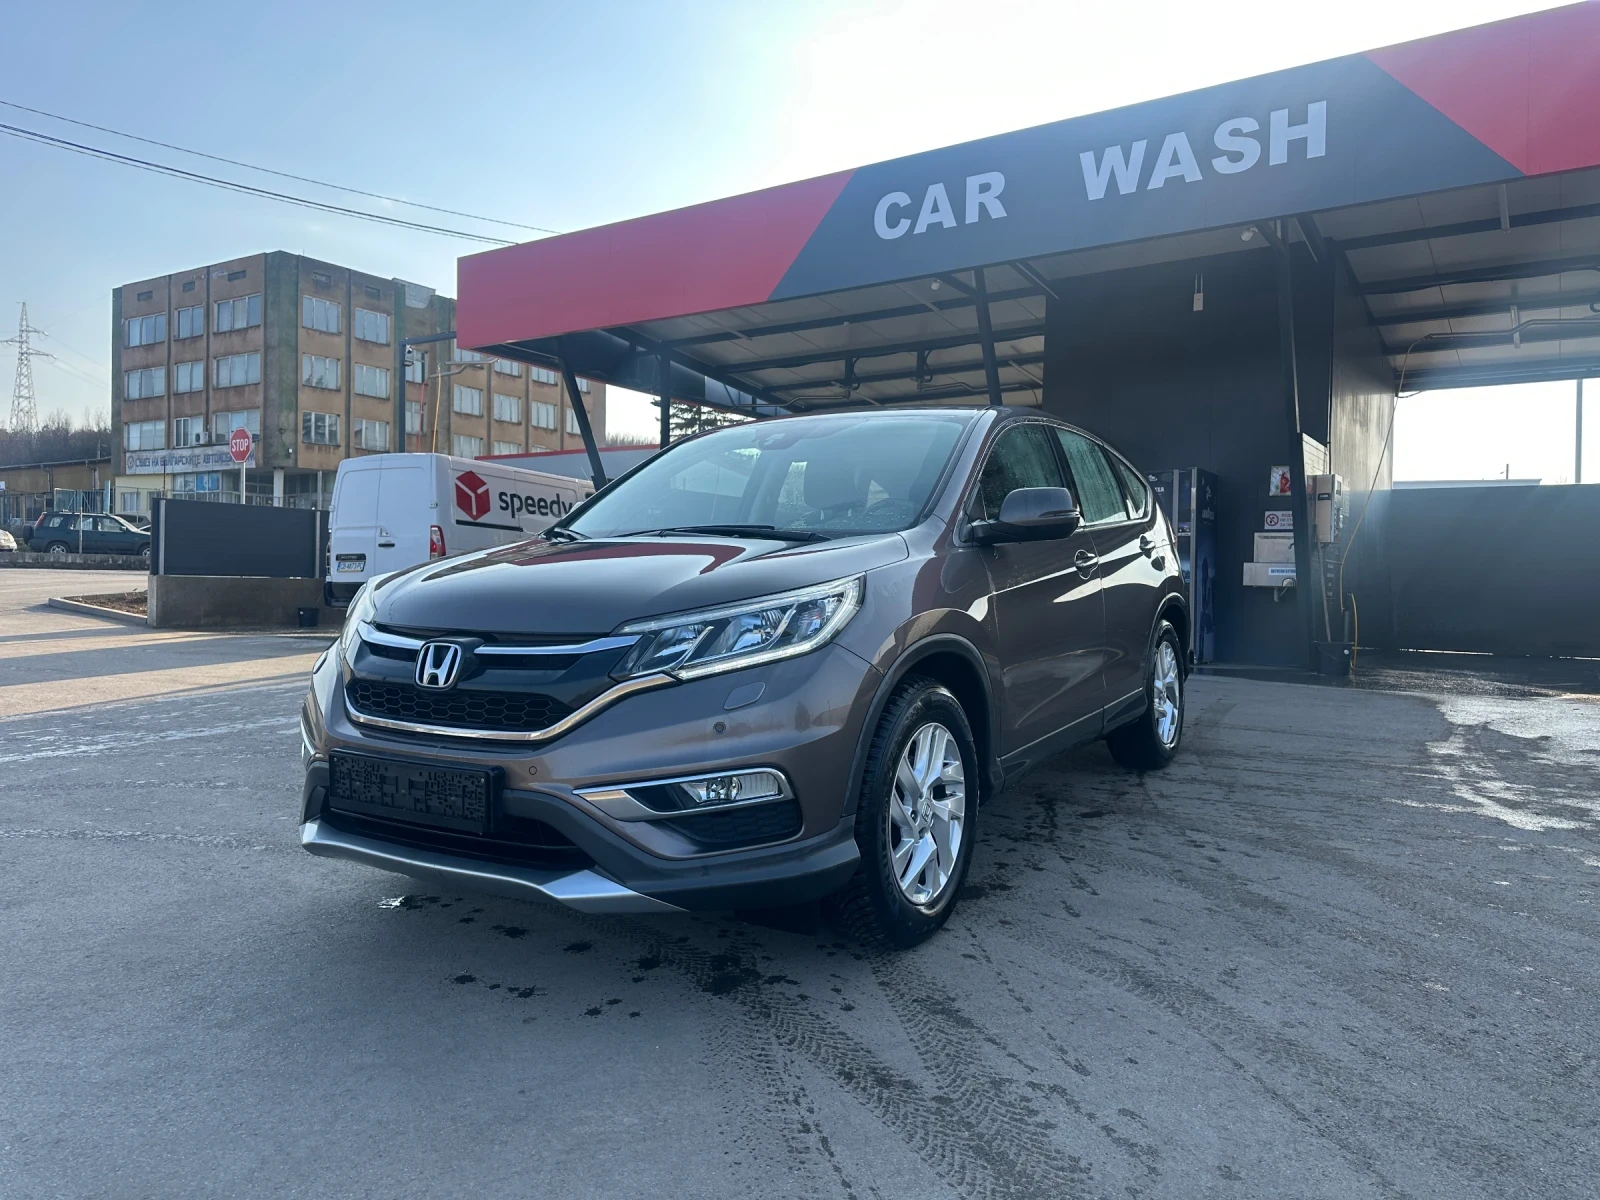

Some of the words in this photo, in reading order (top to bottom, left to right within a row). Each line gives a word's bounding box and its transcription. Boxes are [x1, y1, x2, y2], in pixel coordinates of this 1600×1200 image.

[874, 171, 1008, 240] CAR
[1079, 100, 1327, 201] WASH
[231, 438, 249, 452] STOP
